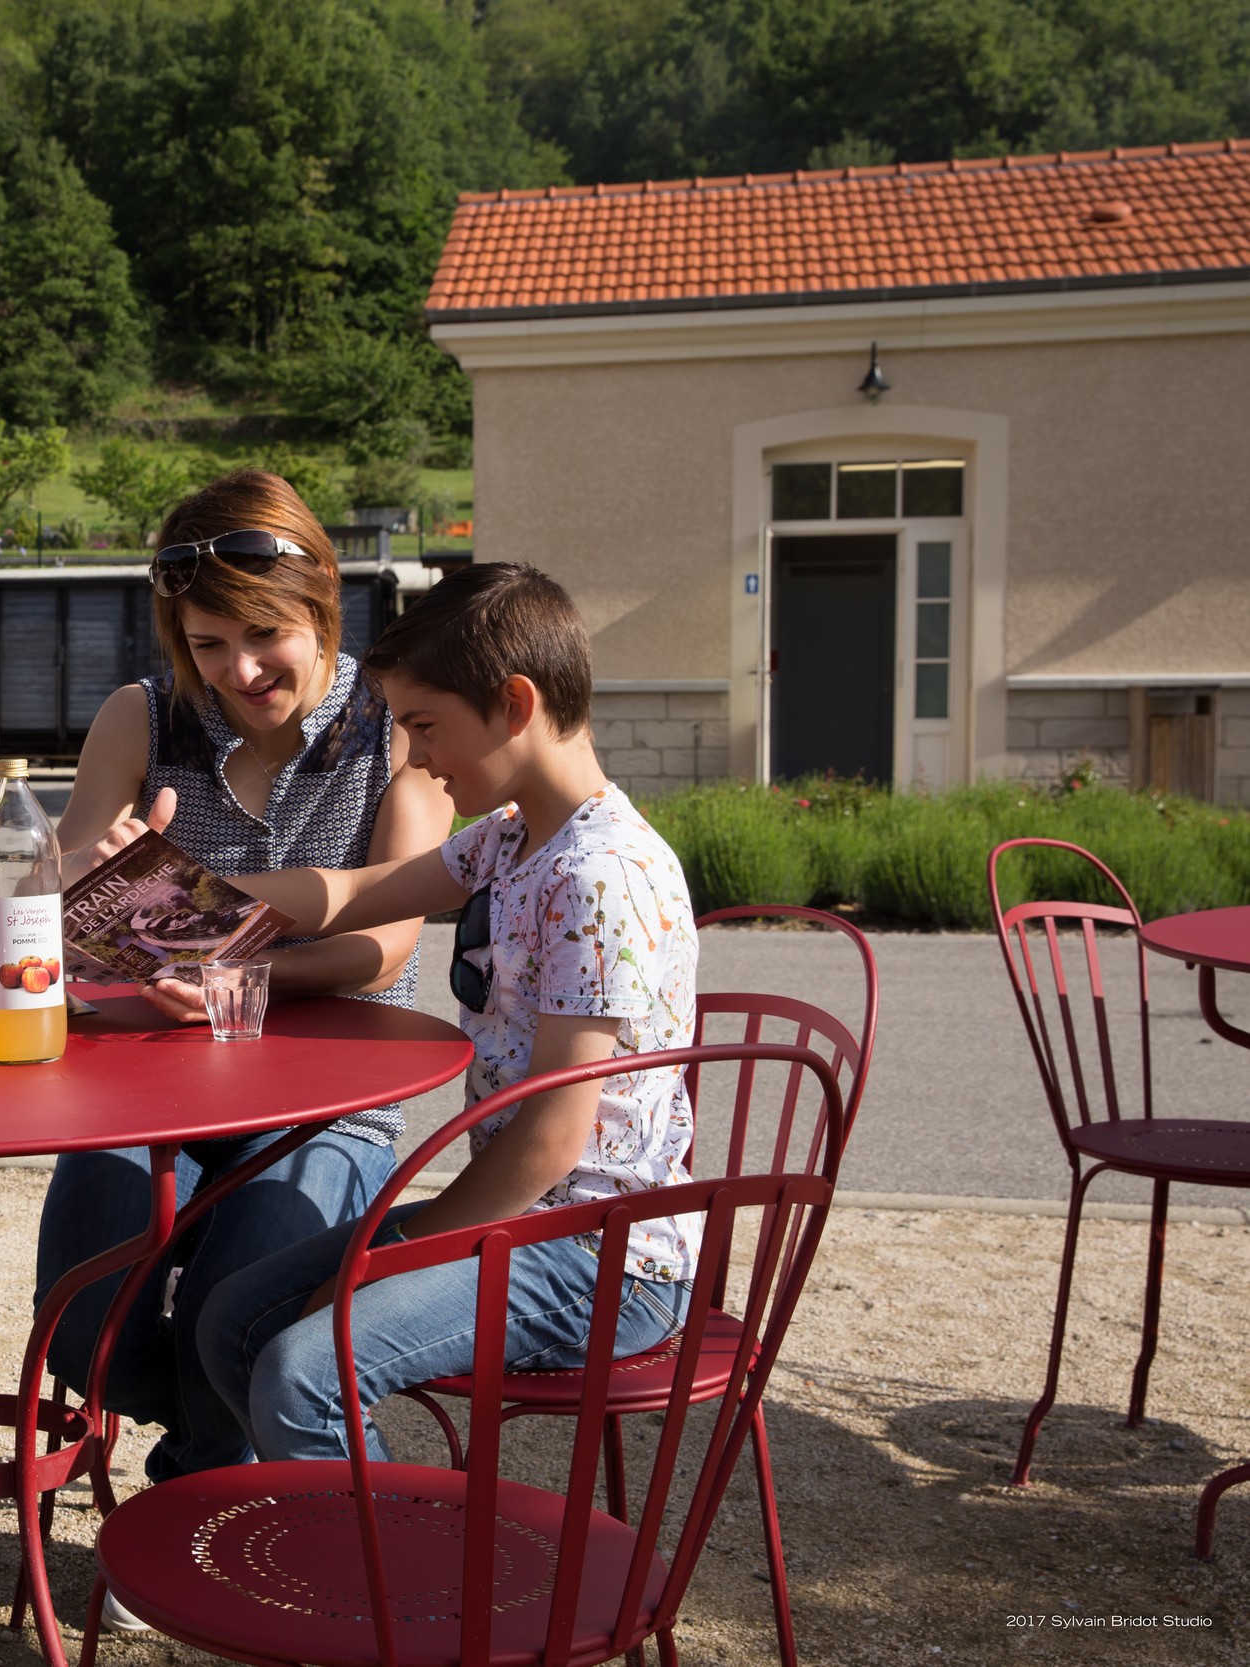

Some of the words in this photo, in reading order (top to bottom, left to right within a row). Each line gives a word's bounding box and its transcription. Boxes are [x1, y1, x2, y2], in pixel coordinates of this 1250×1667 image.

[63, 874, 130, 923] TRAIN
[6, 915, 19, 926] St
[80, 918, 101, 934] DE
